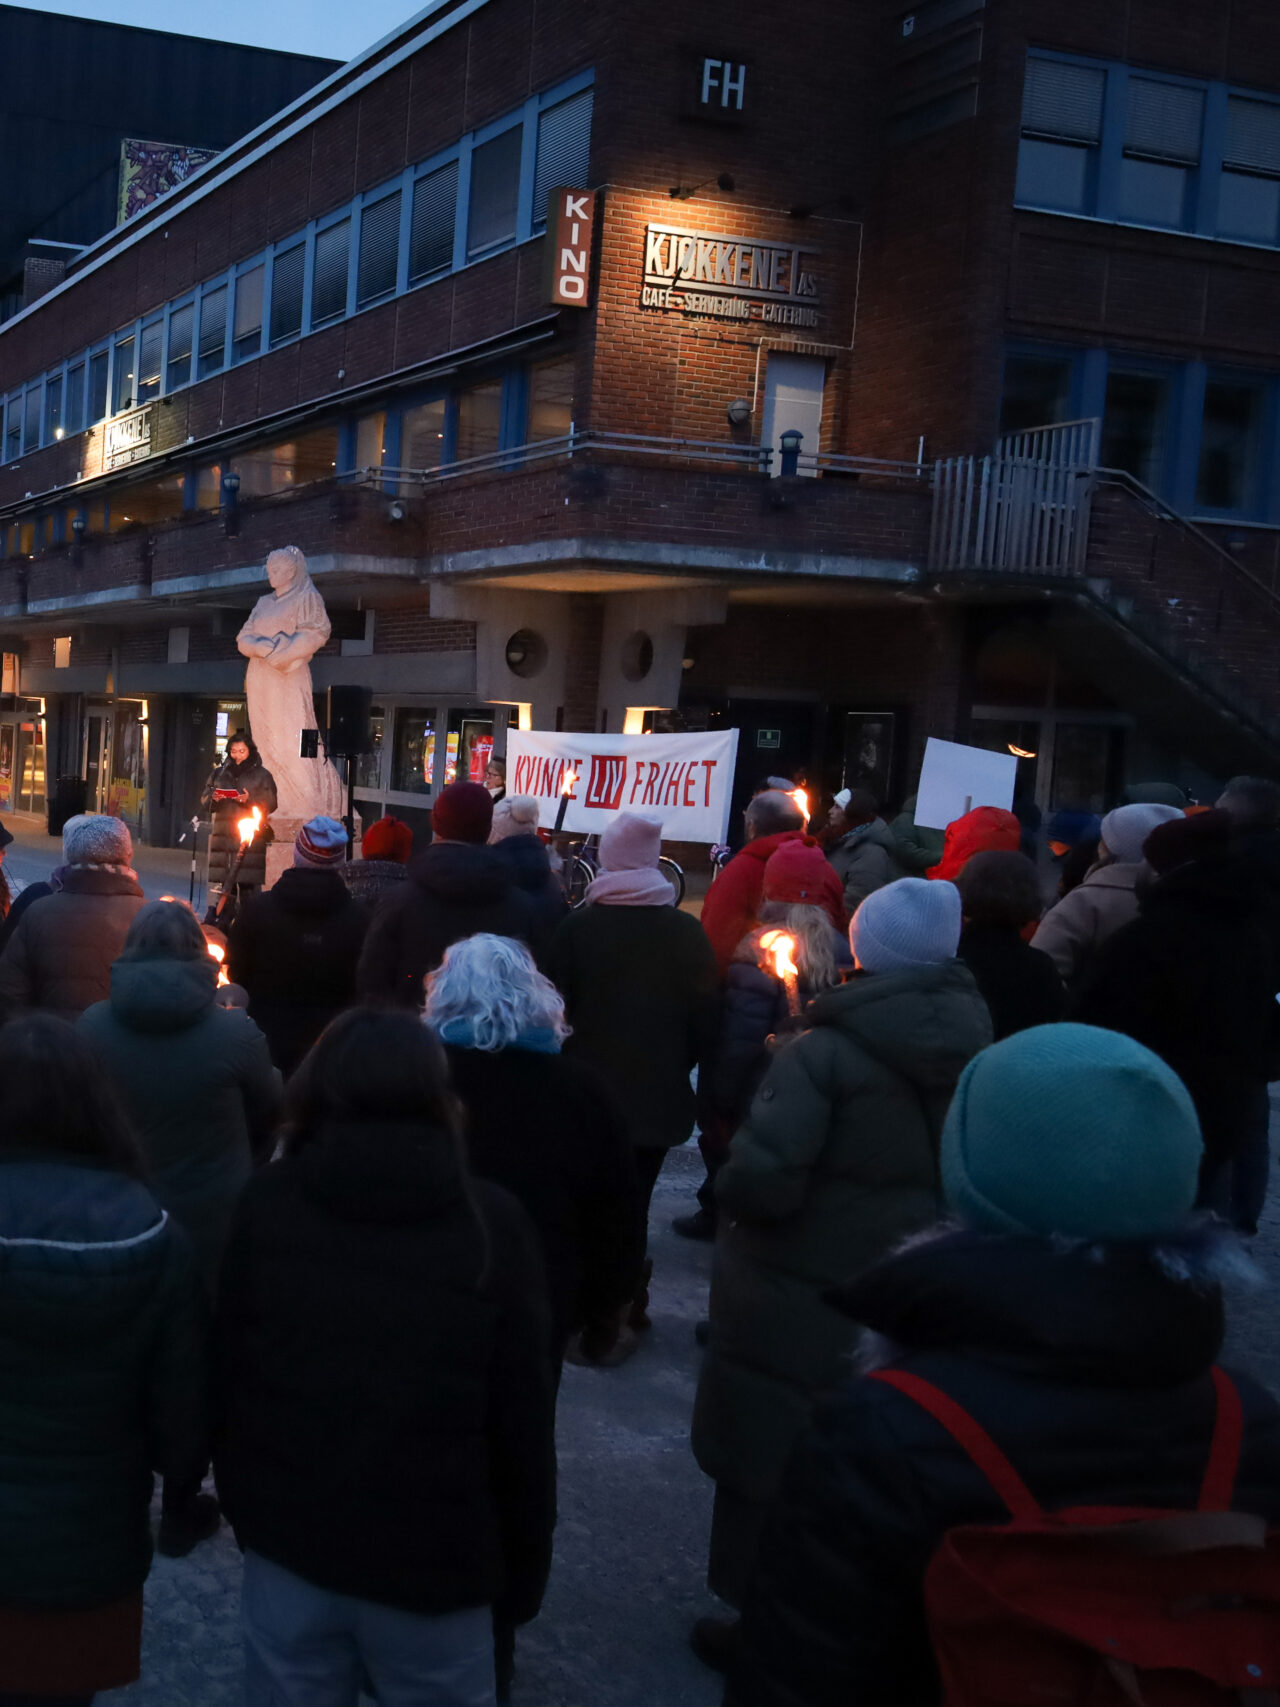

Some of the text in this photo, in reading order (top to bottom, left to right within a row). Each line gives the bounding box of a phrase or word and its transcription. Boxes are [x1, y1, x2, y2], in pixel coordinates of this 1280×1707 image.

[701, 57, 746, 111] FH
[558, 194, 589, 299] KINO
[642, 287, 819, 328] CAFÉ SERVERING CATERING
[796, 272, 817, 297] AS
[514, 754, 717, 808] KVINNE LIV FRIHET
